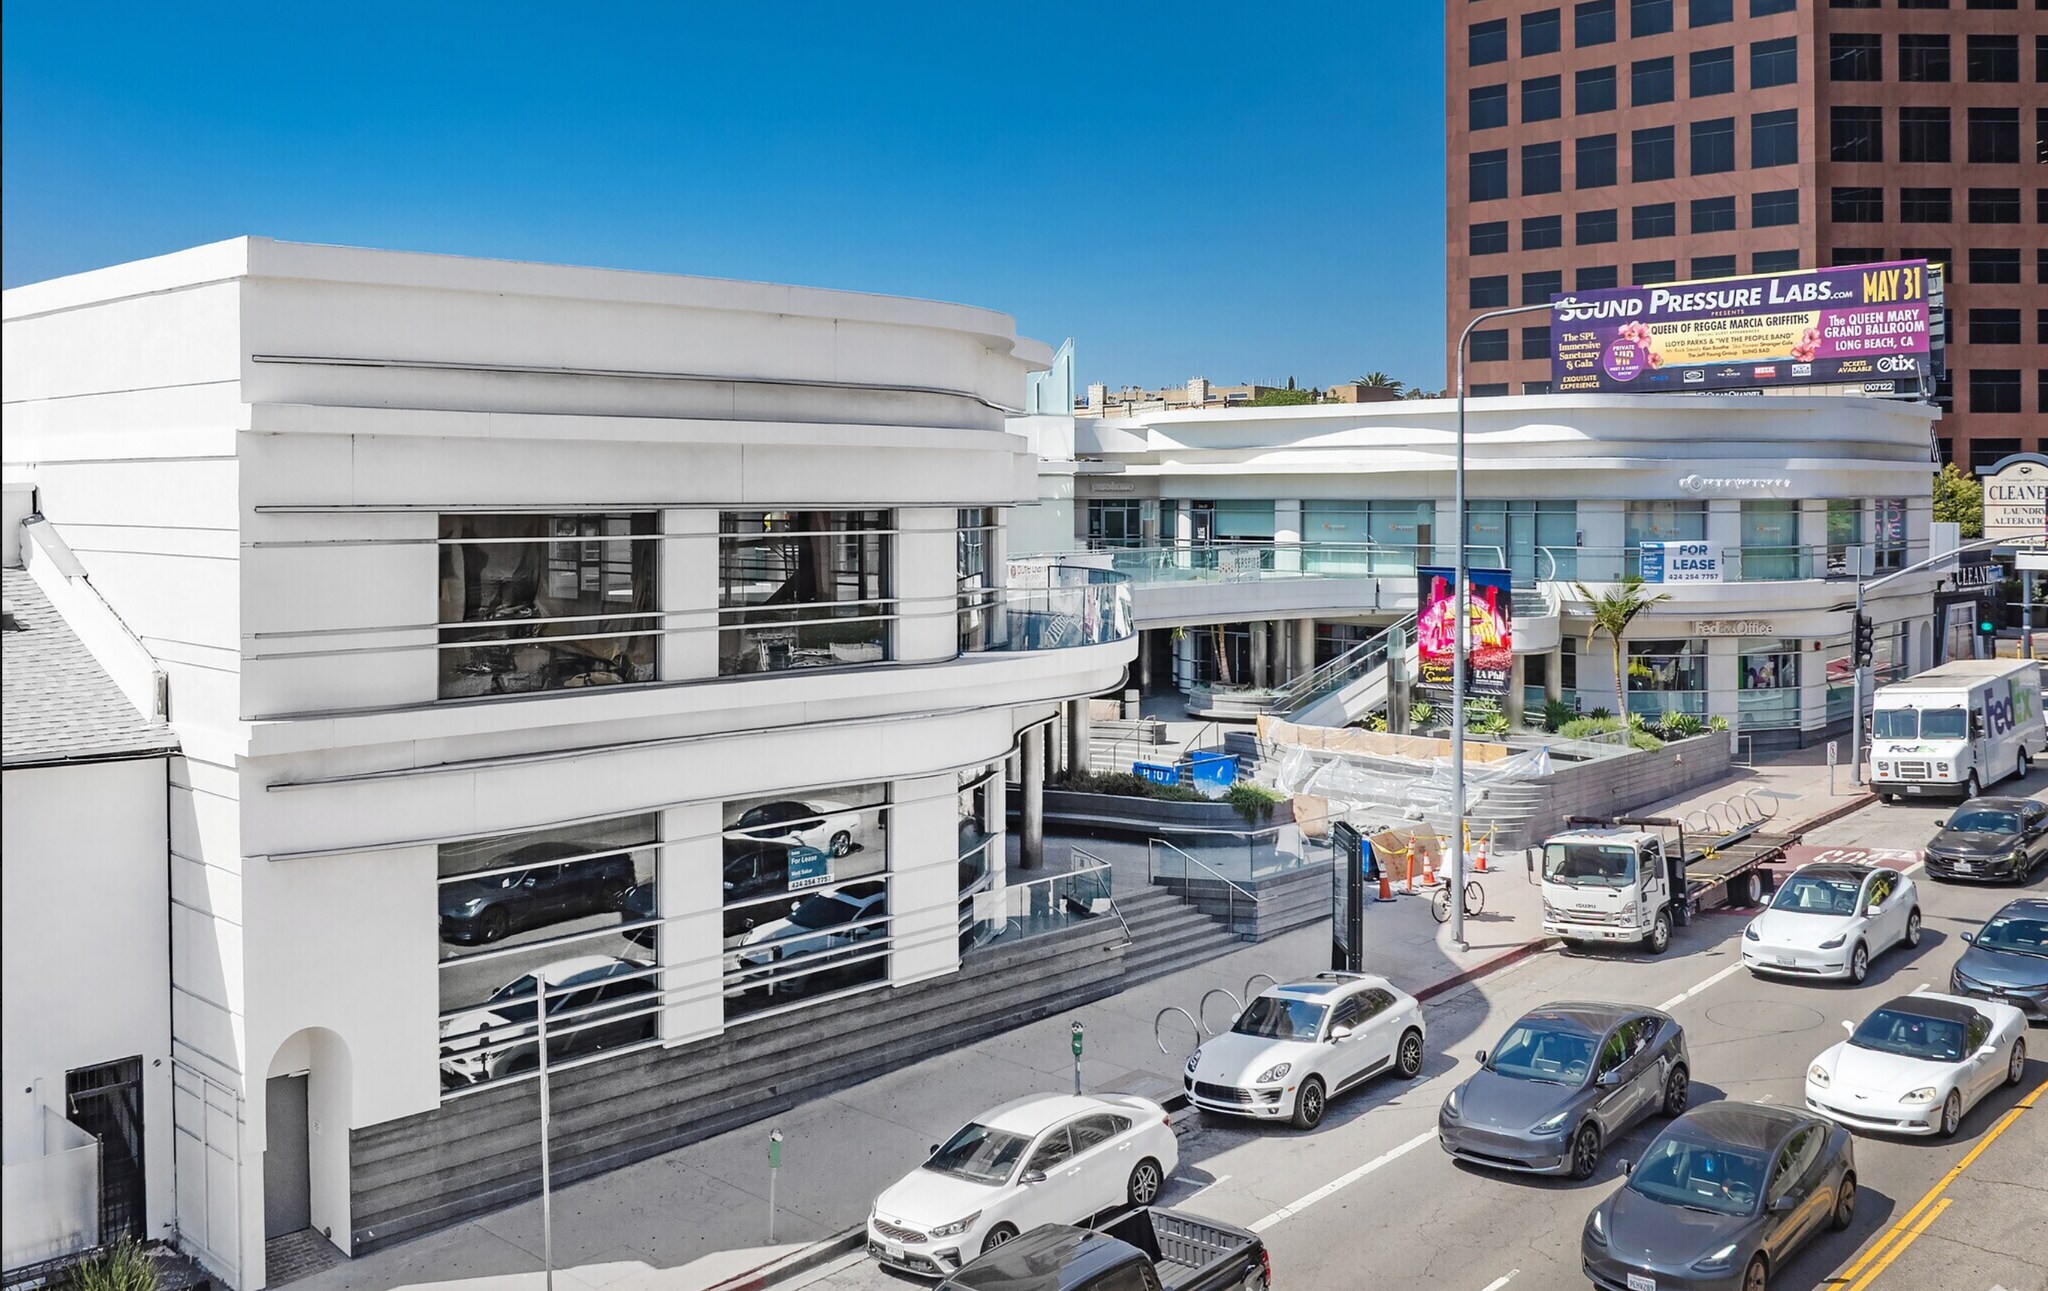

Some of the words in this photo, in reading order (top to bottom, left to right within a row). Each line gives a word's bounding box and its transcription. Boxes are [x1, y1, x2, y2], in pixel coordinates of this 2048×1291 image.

[1863, 269, 1900, 303] MAY
[1903, 267, 1921, 300] 31
[1560, 297, 1642, 321] SOUND
[1649, 288, 1762, 314] PRESSURE
[1711, 308, 1744, 317] PRESENTS
[1829, 314, 1846, 326] The
[1848, 312, 1884, 325] QUEEN
[1887, 309, 1920, 322] MARY
[1651, 323, 1679, 336] QUEEN
[1680, 322, 1692, 333] OF
[1694, 320, 1727, 332] REGGAE
[1729, 317, 1764, 329] MARCIA
[1766, 313, 1810, 327] GRIFFITHS
[1824, 325, 1862, 339] GRAND
[1865, 320, 1925, 336] BALLROOM
[1562, 333, 1579, 342] The
[1579, 332, 1597, 341] SPL
[1665, 340, 1686, 348] LLOYD
[1687, 338, 1708, 346] PARKS
[1744, 333, 1769, 342] PEOPLE
[1559, 341, 1601, 351] Immersive
[1835, 339, 1862, 351] LONG
[1864, 337, 1898, 349] BEACH,
[1900, 336, 1914, 347] CA
[1559, 350, 1601, 362] Sanctuary
[1566, 360, 1574, 371] &
[1574, 358, 1594, 368] Gala
[1842, 360, 1867, 368] TICKETS
[1877, 354, 1916, 372] etix
[1838, 365, 1873, 374] AVAILABLE
[1563, 374, 1598, 383] EXQUISITE
[1560, 381, 1600, 391] EXPERIENCE
[1864, 382, 1894, 392] 007122
[1989, 485, 2046, 500] CLEANE
[1995, 517, 2047, 525] ALTERATIO
[1679, 545, 1708, 556] FOR
[1672, 559, 1715, 570] LEASE
[1691, 620, 1736, 636] FedEx
[1735, 620, 1775, 636] Office
[1476, 670, 1487, 679] LA
[1487, 670, 1504, 680] Phil
[1984, 675, 2033, 739] FedEx
[1888, 745, 1938, 753] FedEx
[791, 857, 801, 865] For
[801, 855, 817, 863] Lease
